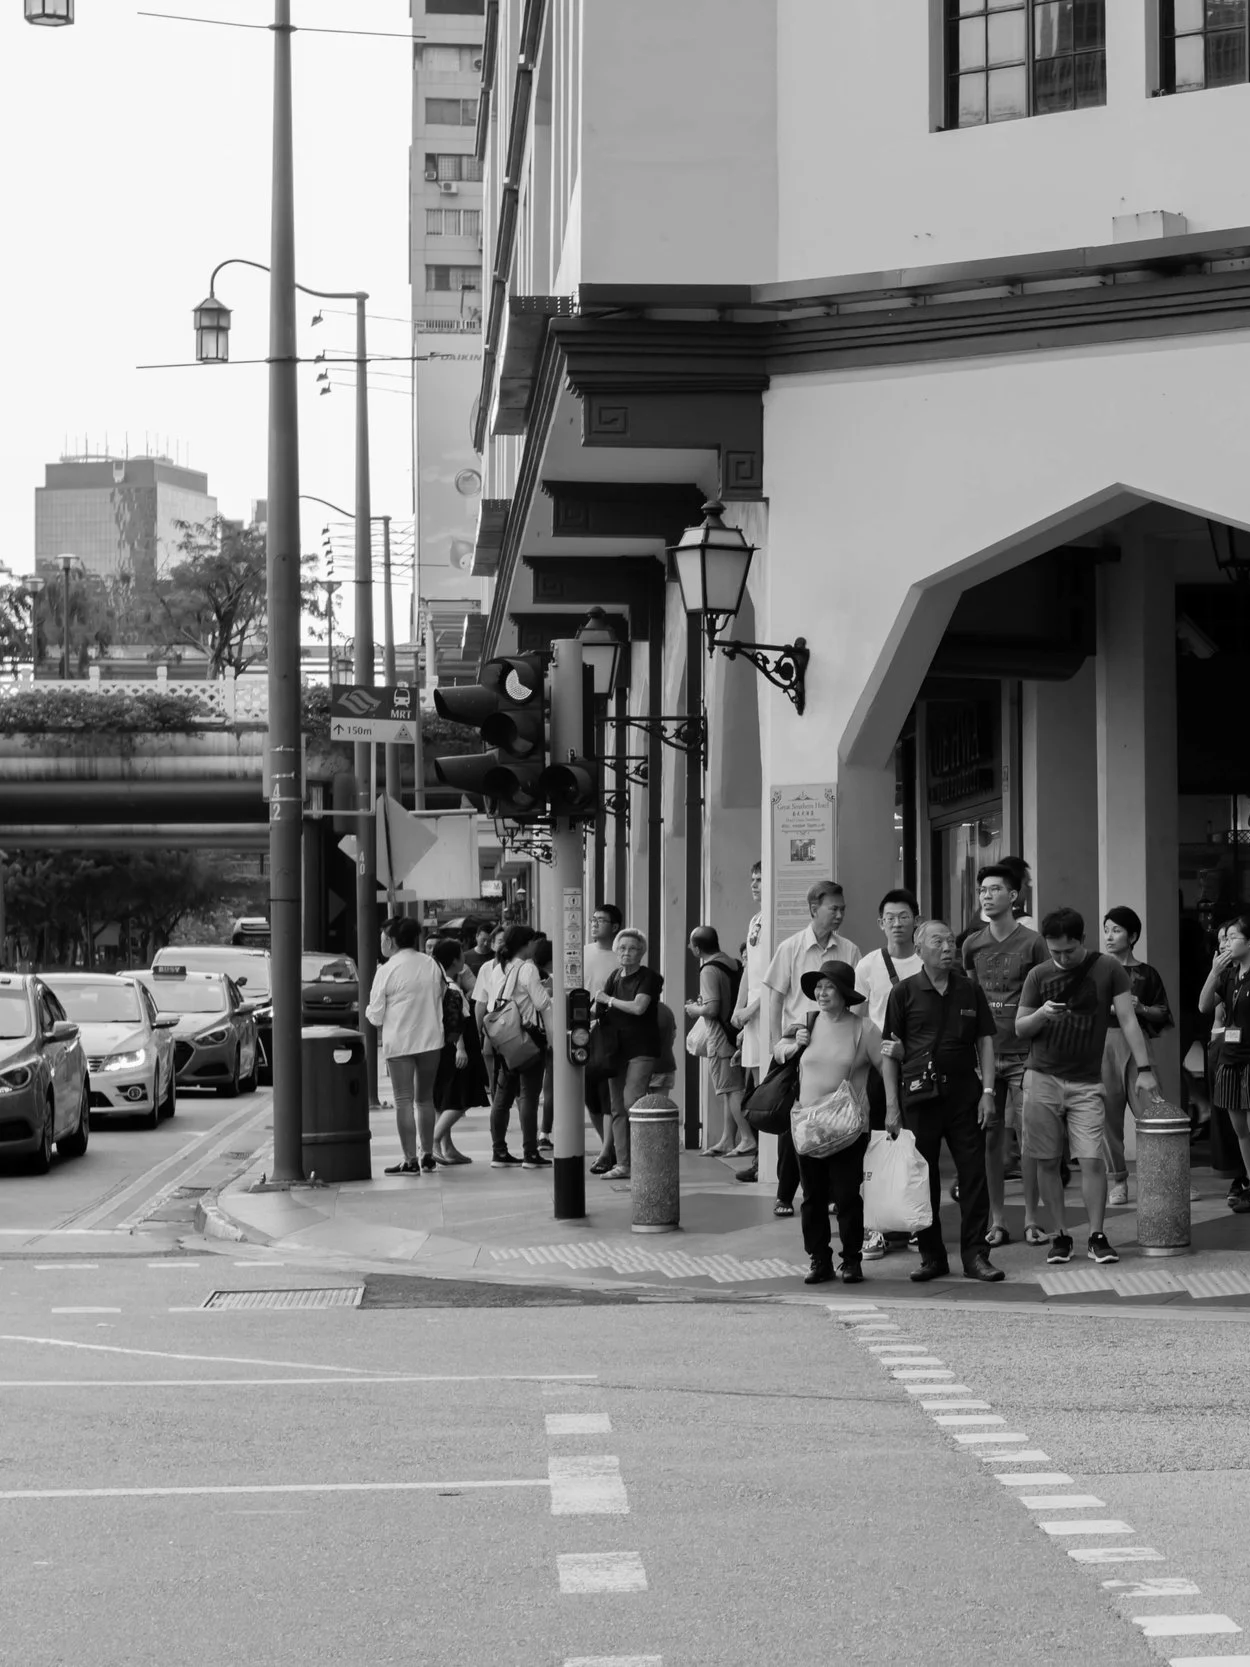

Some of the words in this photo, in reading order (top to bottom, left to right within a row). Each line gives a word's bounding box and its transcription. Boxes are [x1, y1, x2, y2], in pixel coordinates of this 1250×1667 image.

[390, 709, 412, 719] MRT
[347, 726, 372, 735] 150m
[272, 783, 281, 820] 42
